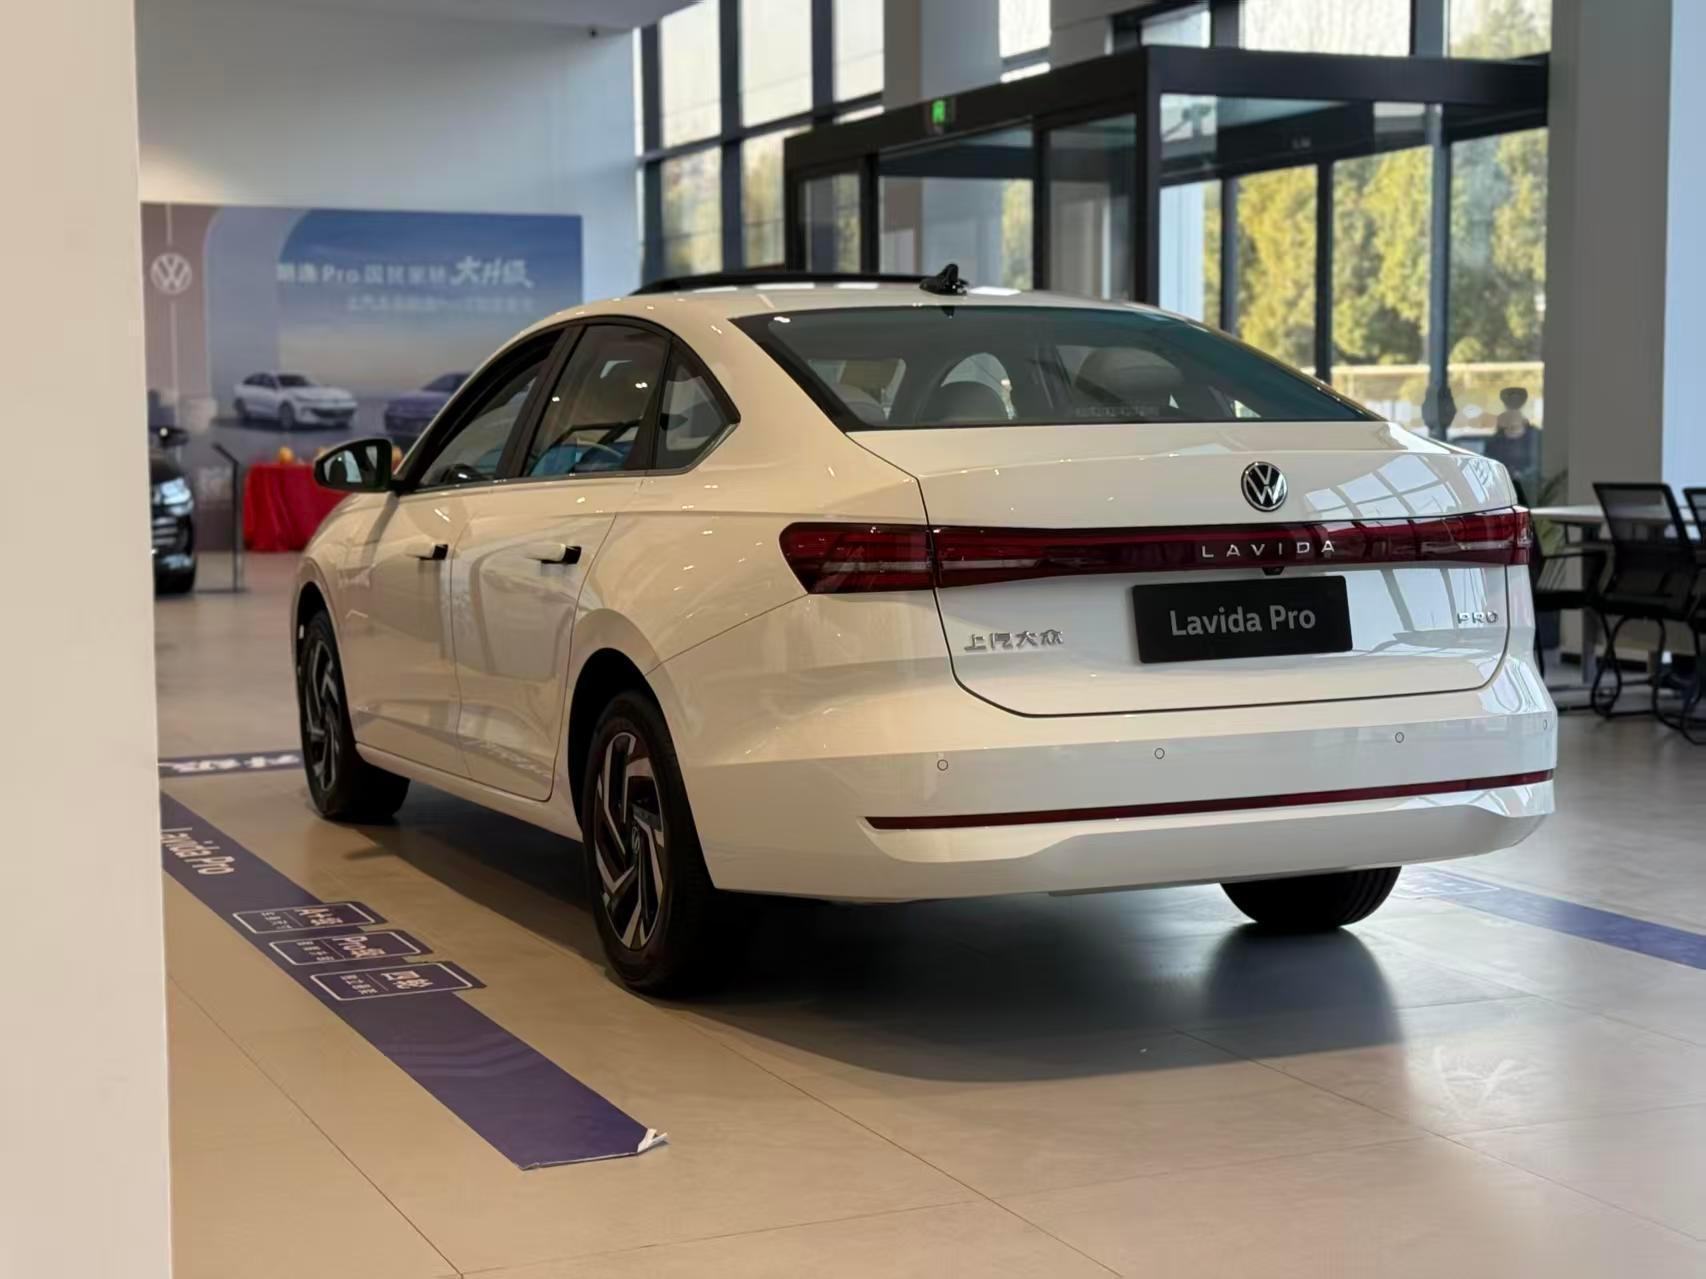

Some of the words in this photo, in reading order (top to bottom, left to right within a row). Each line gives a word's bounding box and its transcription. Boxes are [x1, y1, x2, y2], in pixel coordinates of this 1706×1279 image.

[1201, 540, 1336, 560] LAVIDA
[1169, 607, 1262, 637] Lavida
[1269, 604, 1317, 632] Pro
[1456, 609, 1499, 626] PRO
[963, 629, 1064, 652] 上汽大众
[184, 855, 236, 876] Pro
